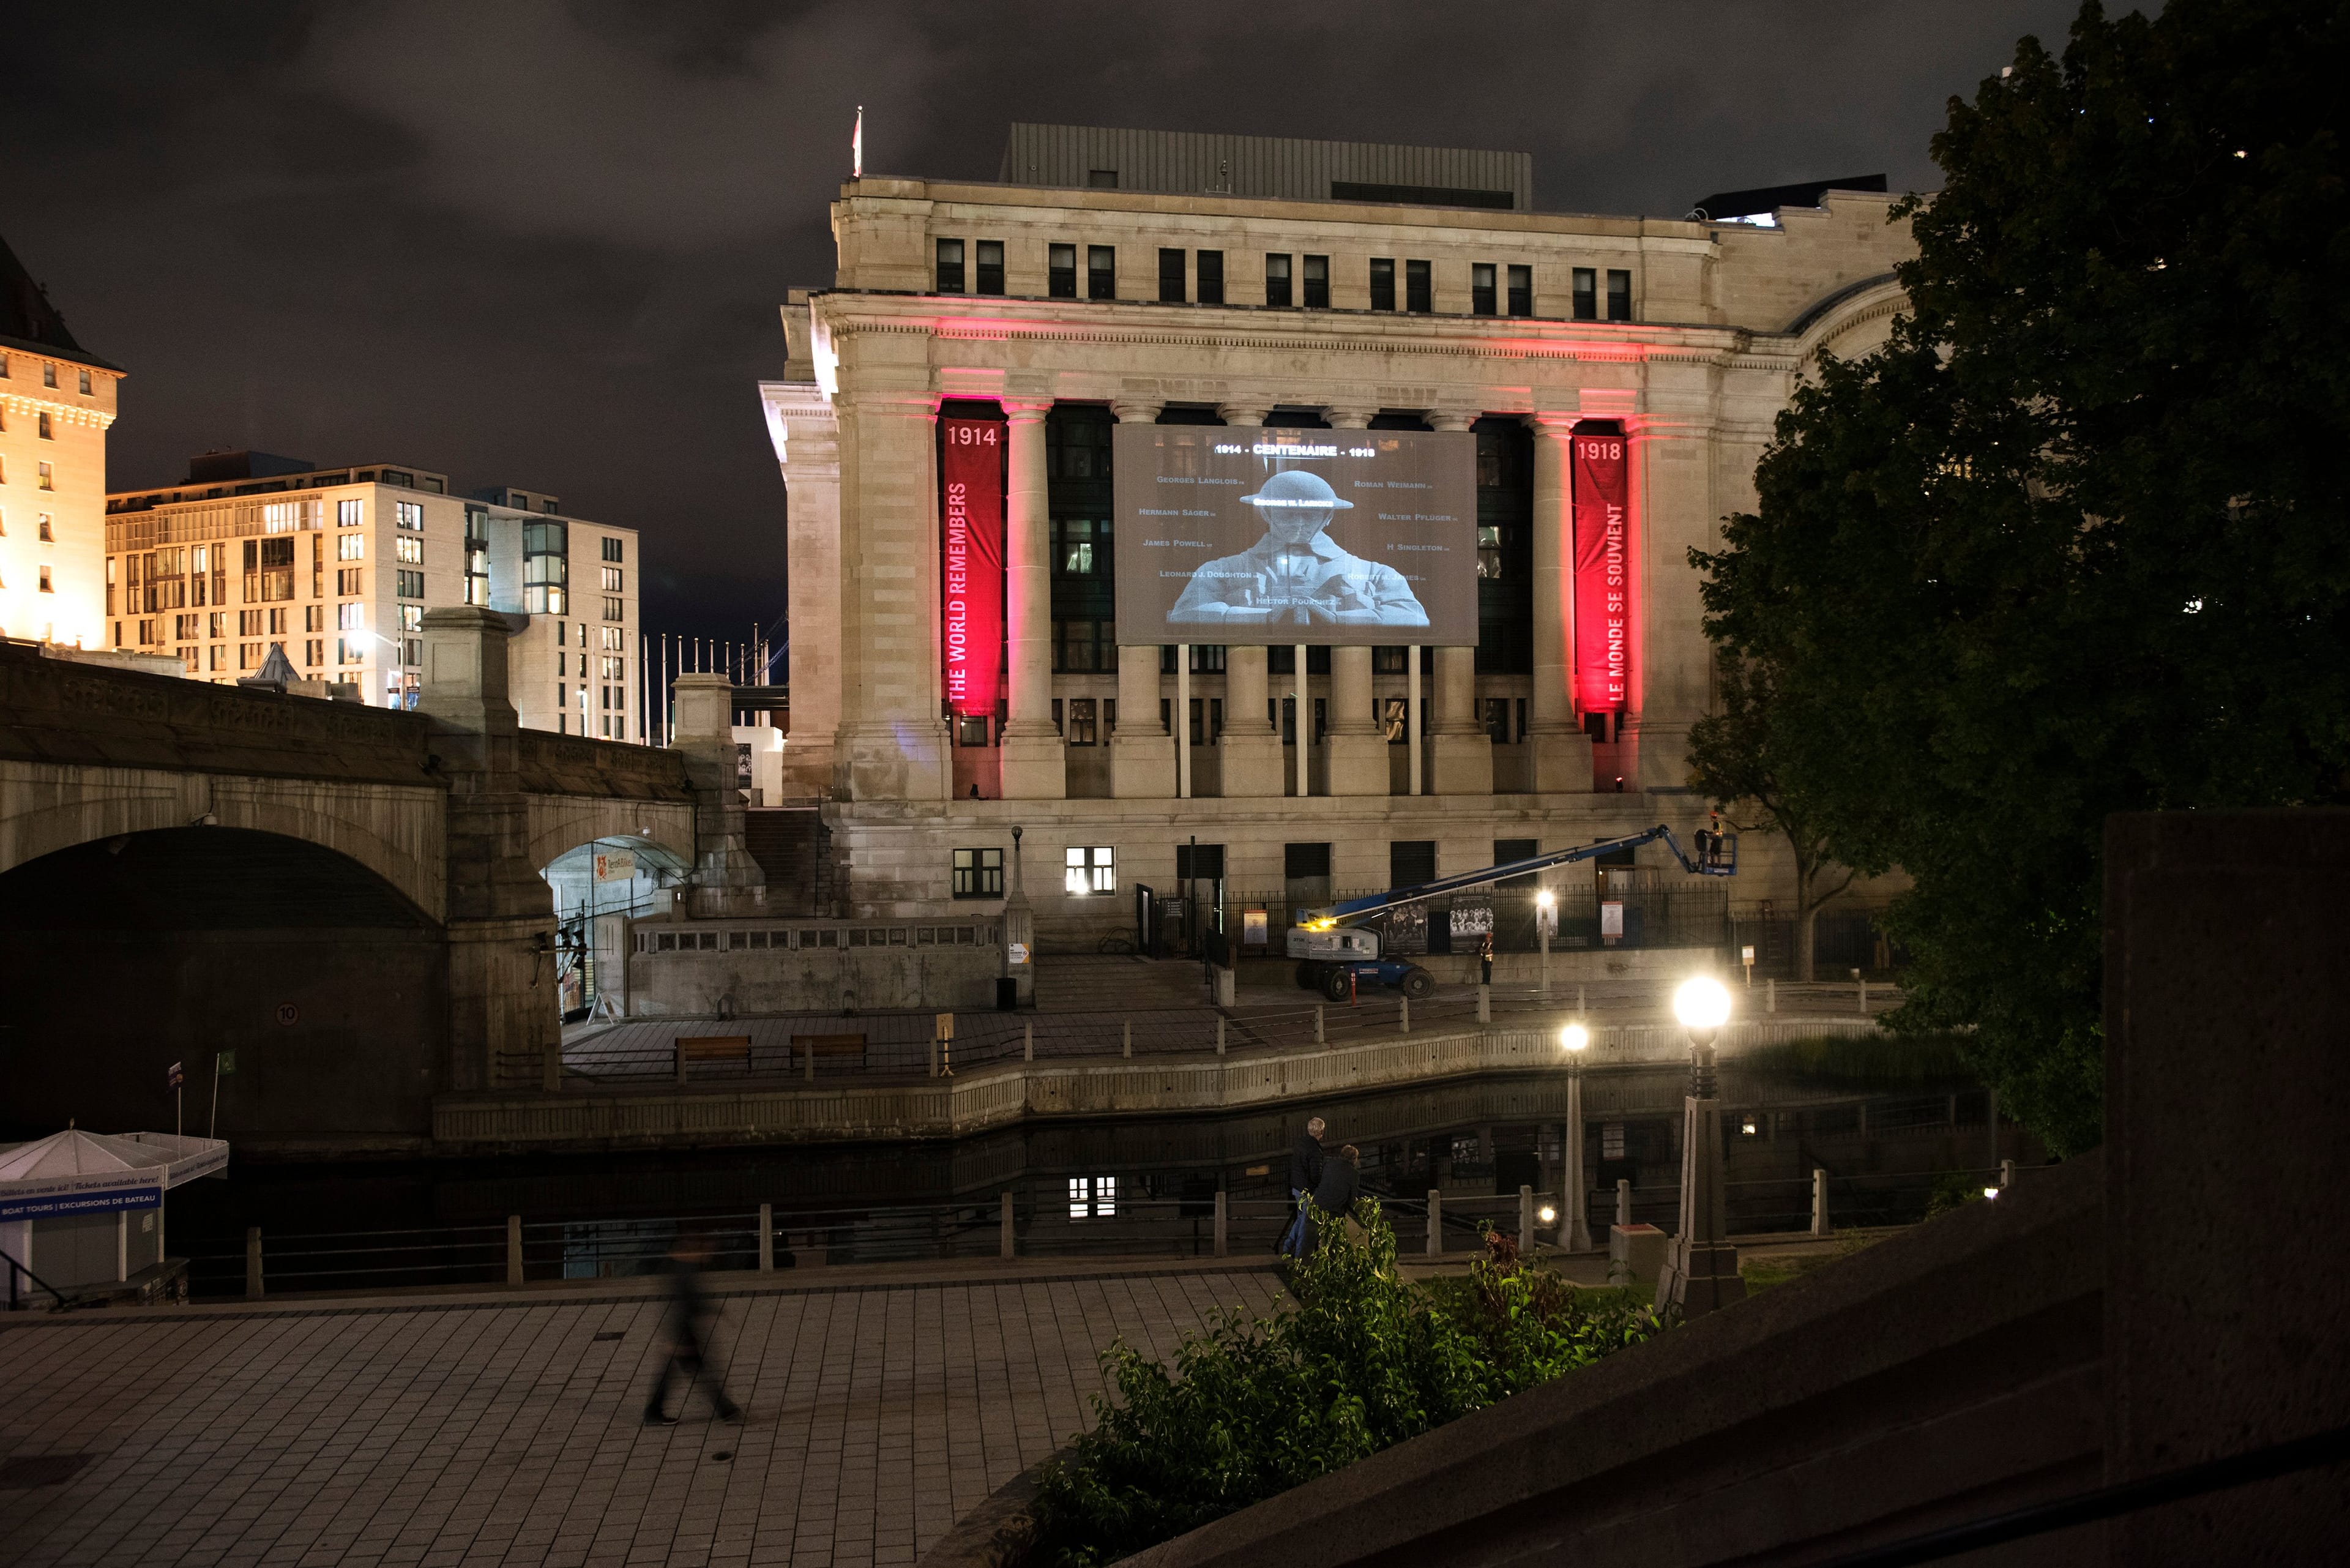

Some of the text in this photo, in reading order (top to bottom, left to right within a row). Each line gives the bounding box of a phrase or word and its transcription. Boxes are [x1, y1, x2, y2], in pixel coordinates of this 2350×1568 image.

[949, 427, 996, 446] 1914
[1214, 444, 1242, 454] 1914
[1253, 444, 1337, 457] CENTENAIRE
[1349, 448, 1375, 458] 1918
[1578, 442, 1621, 461] 1918
[949, 482, 966, 703] THE WORLD REMEMBERS
[1606, 503, 1624, 701] LE MONDE SE SOUVIENT
[279, 1007, 295, 1020] 10
[75, 1182, 101, 1190] Tickets
[102, 1178, 138, 1187] available
[140, 1176, 159, 1184] here!
[2, 1206, 24, 1215] BOAT
[26, 1204, 54, 1212] TOURS
[59, 1199, 110, 1210] EXCURSIONS
[125, 1195, 156, 1204] BATEAU
